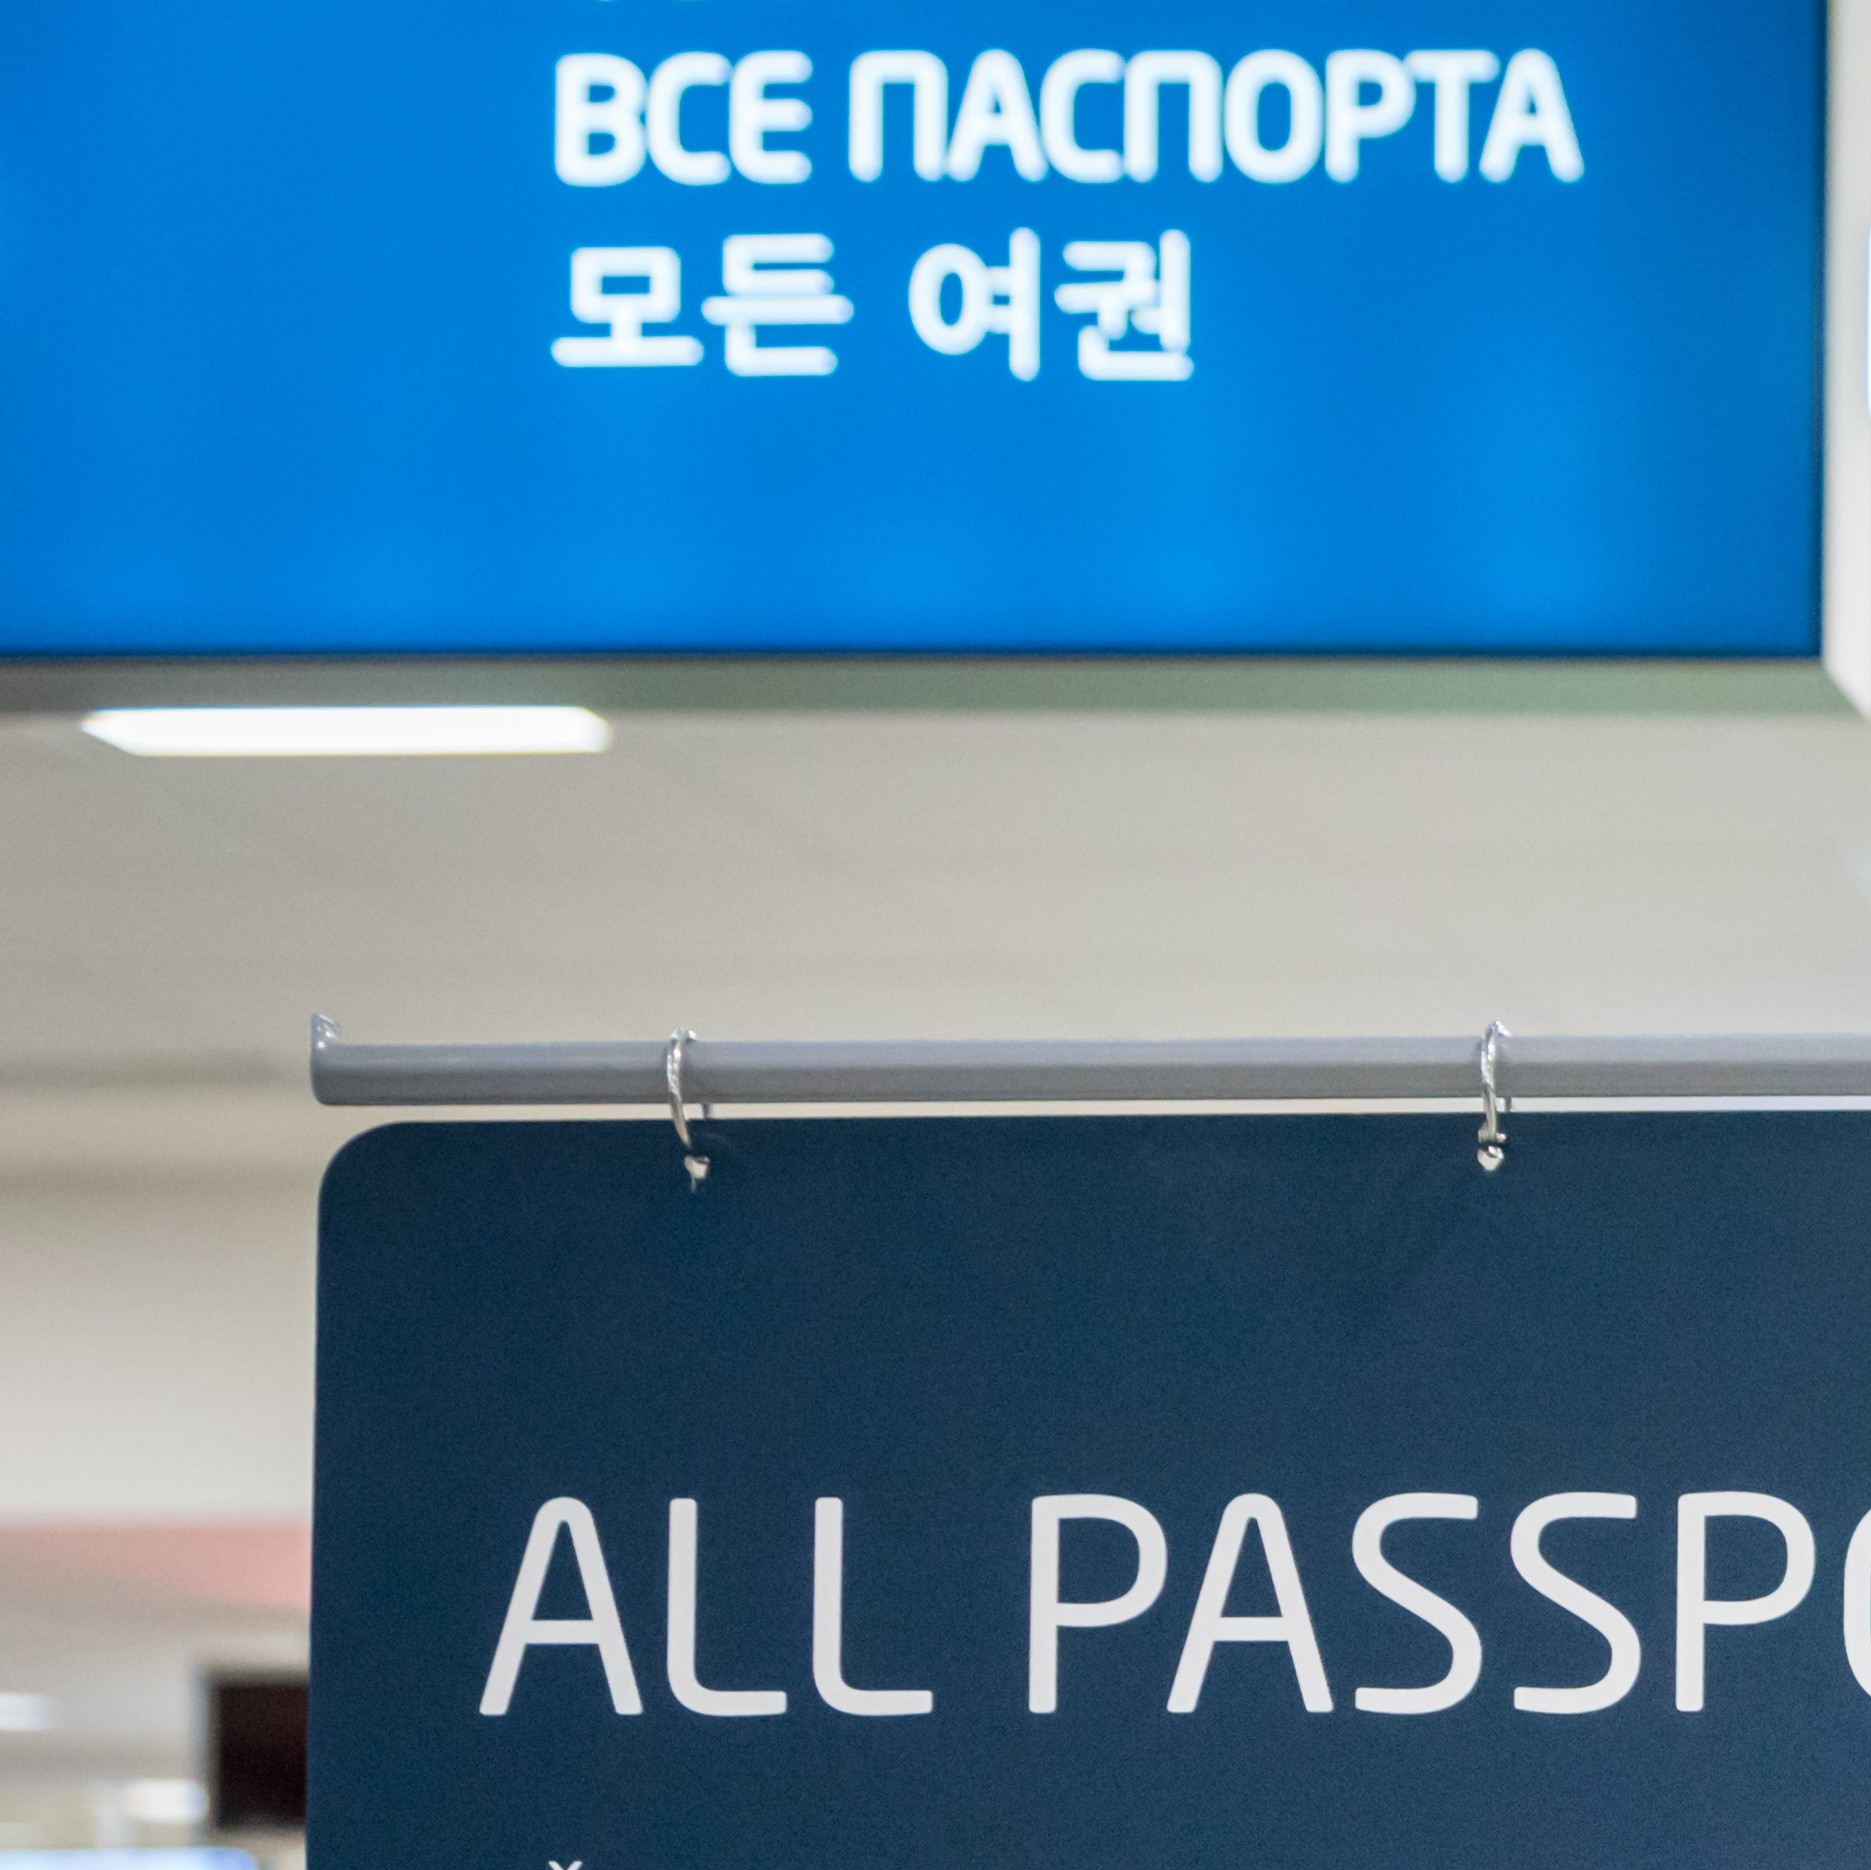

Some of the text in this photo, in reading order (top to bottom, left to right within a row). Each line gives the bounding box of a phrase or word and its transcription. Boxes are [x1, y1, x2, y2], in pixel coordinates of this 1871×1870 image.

[553, 47, 1585, 188] ВСЕ ПАСПОРТА
[550, 226, 1195, 382] 모든 여권
[478, 1495, 935, 1718] ALL
